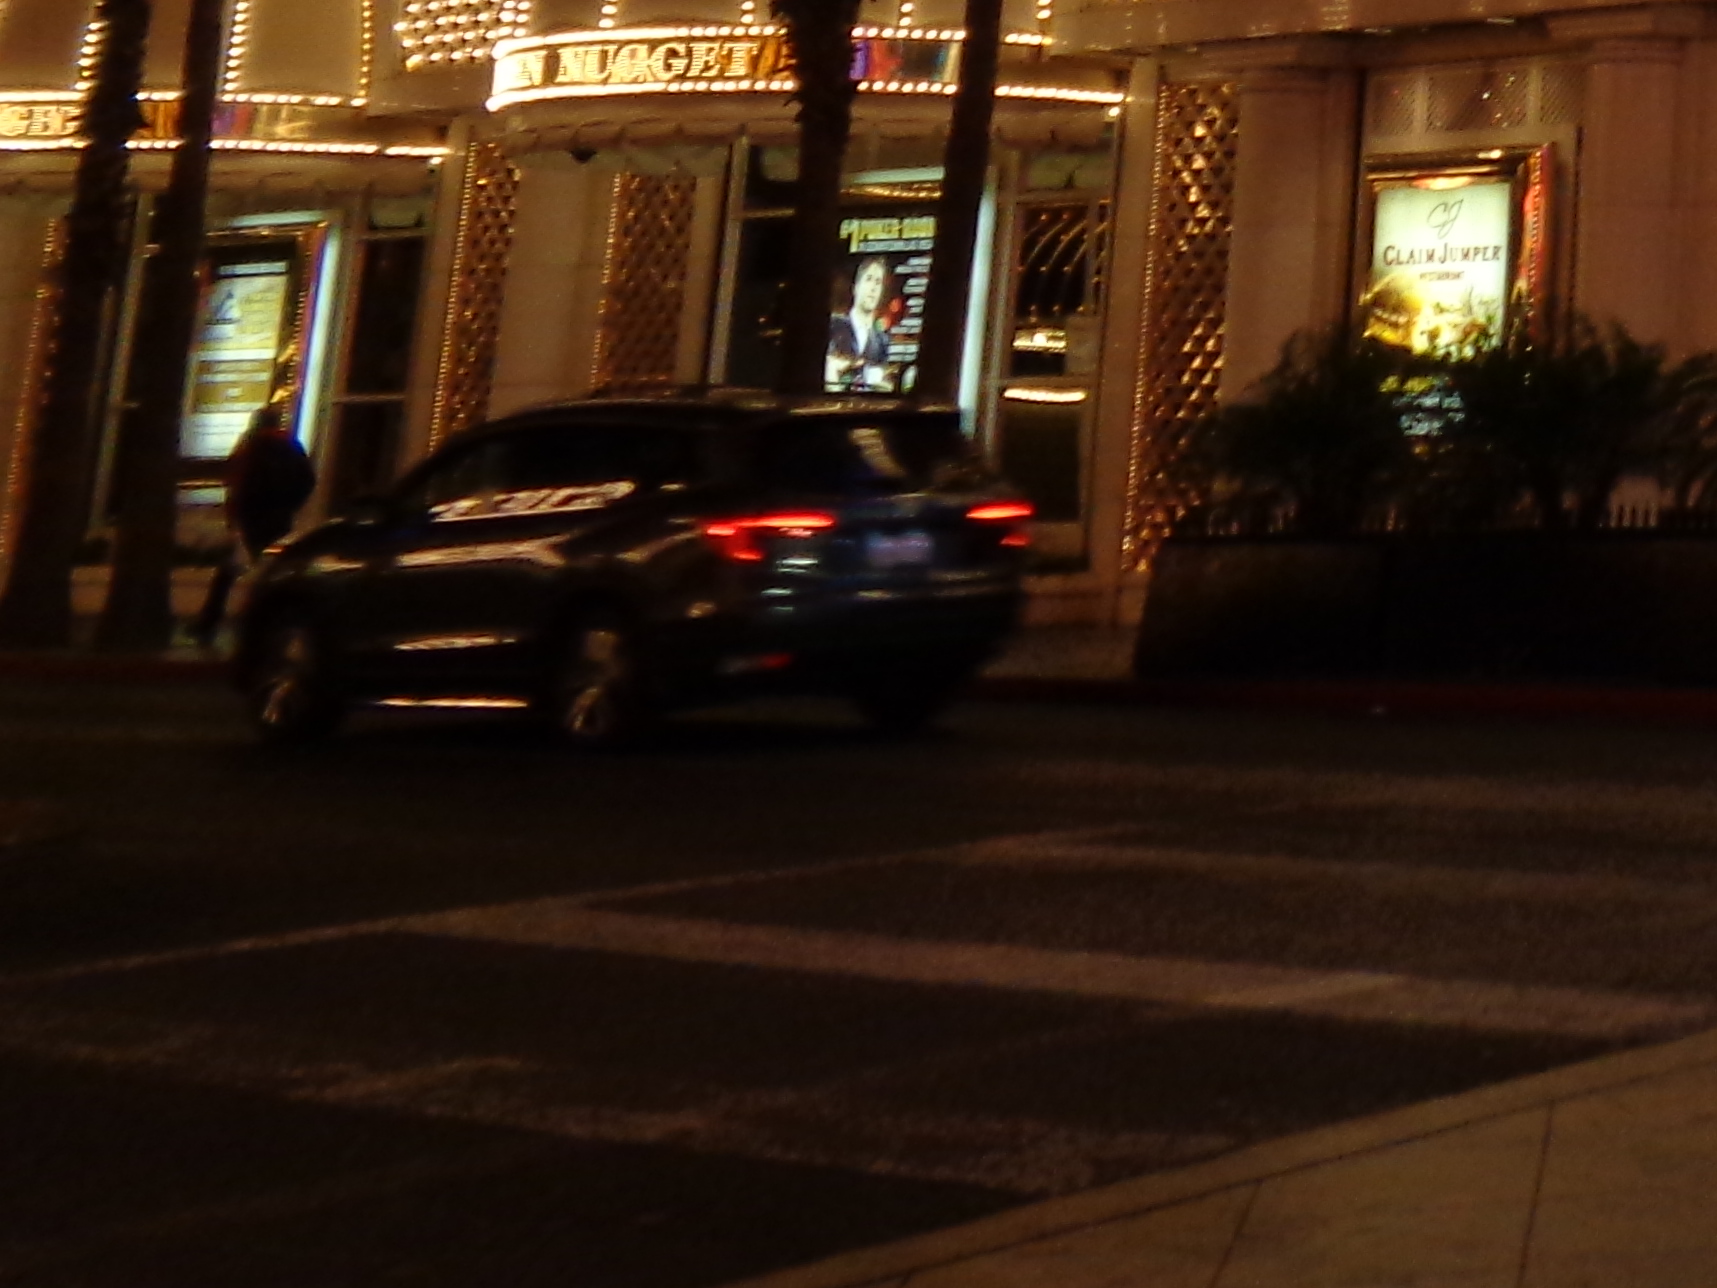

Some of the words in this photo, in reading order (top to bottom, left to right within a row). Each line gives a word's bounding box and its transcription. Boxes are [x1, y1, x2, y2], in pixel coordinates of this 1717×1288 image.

[556, 41, 759, 85] NUGGET
[1382, 244, 1437, 266] CLAIM
[1438, 242, 1503, 265] JUMPER
